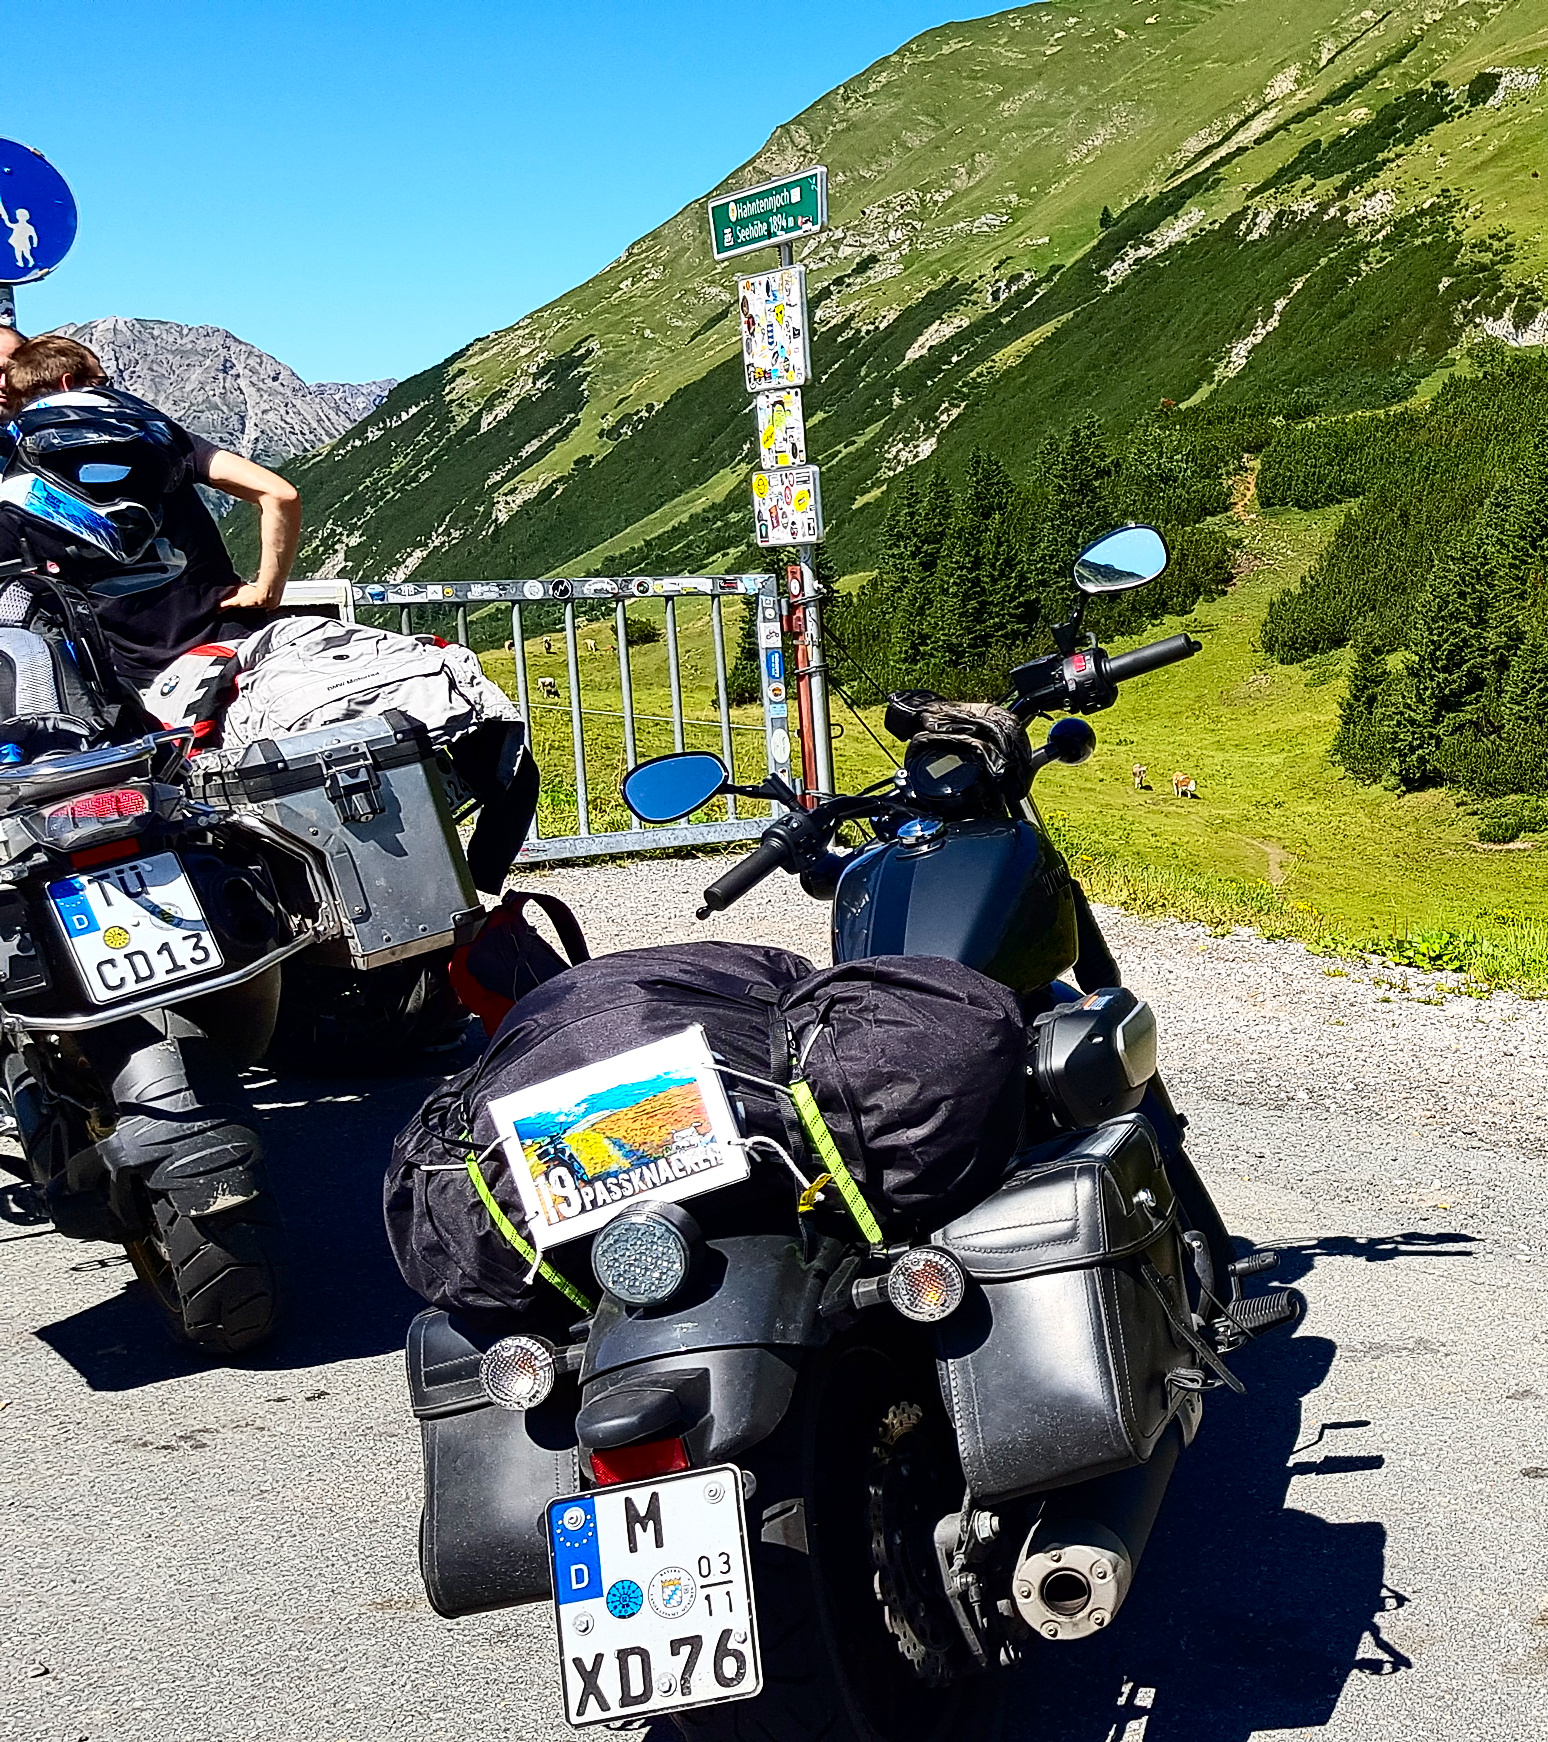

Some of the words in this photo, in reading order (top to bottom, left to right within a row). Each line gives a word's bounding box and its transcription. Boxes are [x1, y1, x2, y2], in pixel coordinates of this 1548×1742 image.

[736, 188, 790, 219] Hahntennjoch
[736, 220, 768, 243] Seehöhe
[768, 213, 787, 233] 1894
[88, 864, 151, 907] TÜ
[72, 914, 89, 930] D
[624, 1491, 664, 1554] M
[569, 1563, 590, 1590] D
[697, 1552, 732, 1579] 03
[704, 1590, 734, 1617] 11
